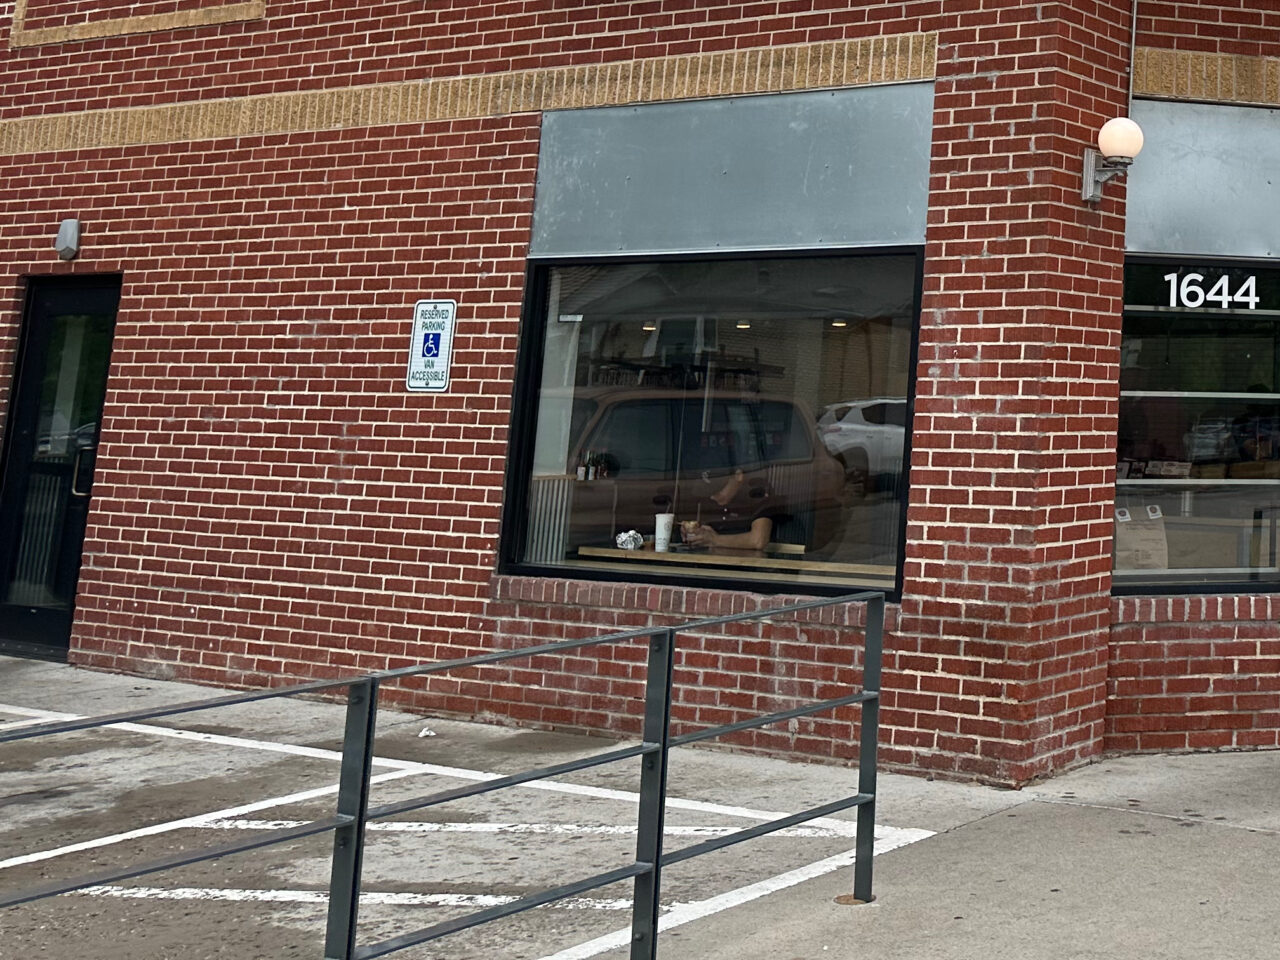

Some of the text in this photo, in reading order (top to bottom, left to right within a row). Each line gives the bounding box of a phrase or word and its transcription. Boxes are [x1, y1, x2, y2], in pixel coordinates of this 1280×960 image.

[1163, 272, 1260, 310] 1644
[420, 310, 449, 319] RESERVED
[421, 321, 445, 330] PARKING
[424, 359, 435, 369] VAN
[411, 371, 445, 381] ACCESSIBLE
